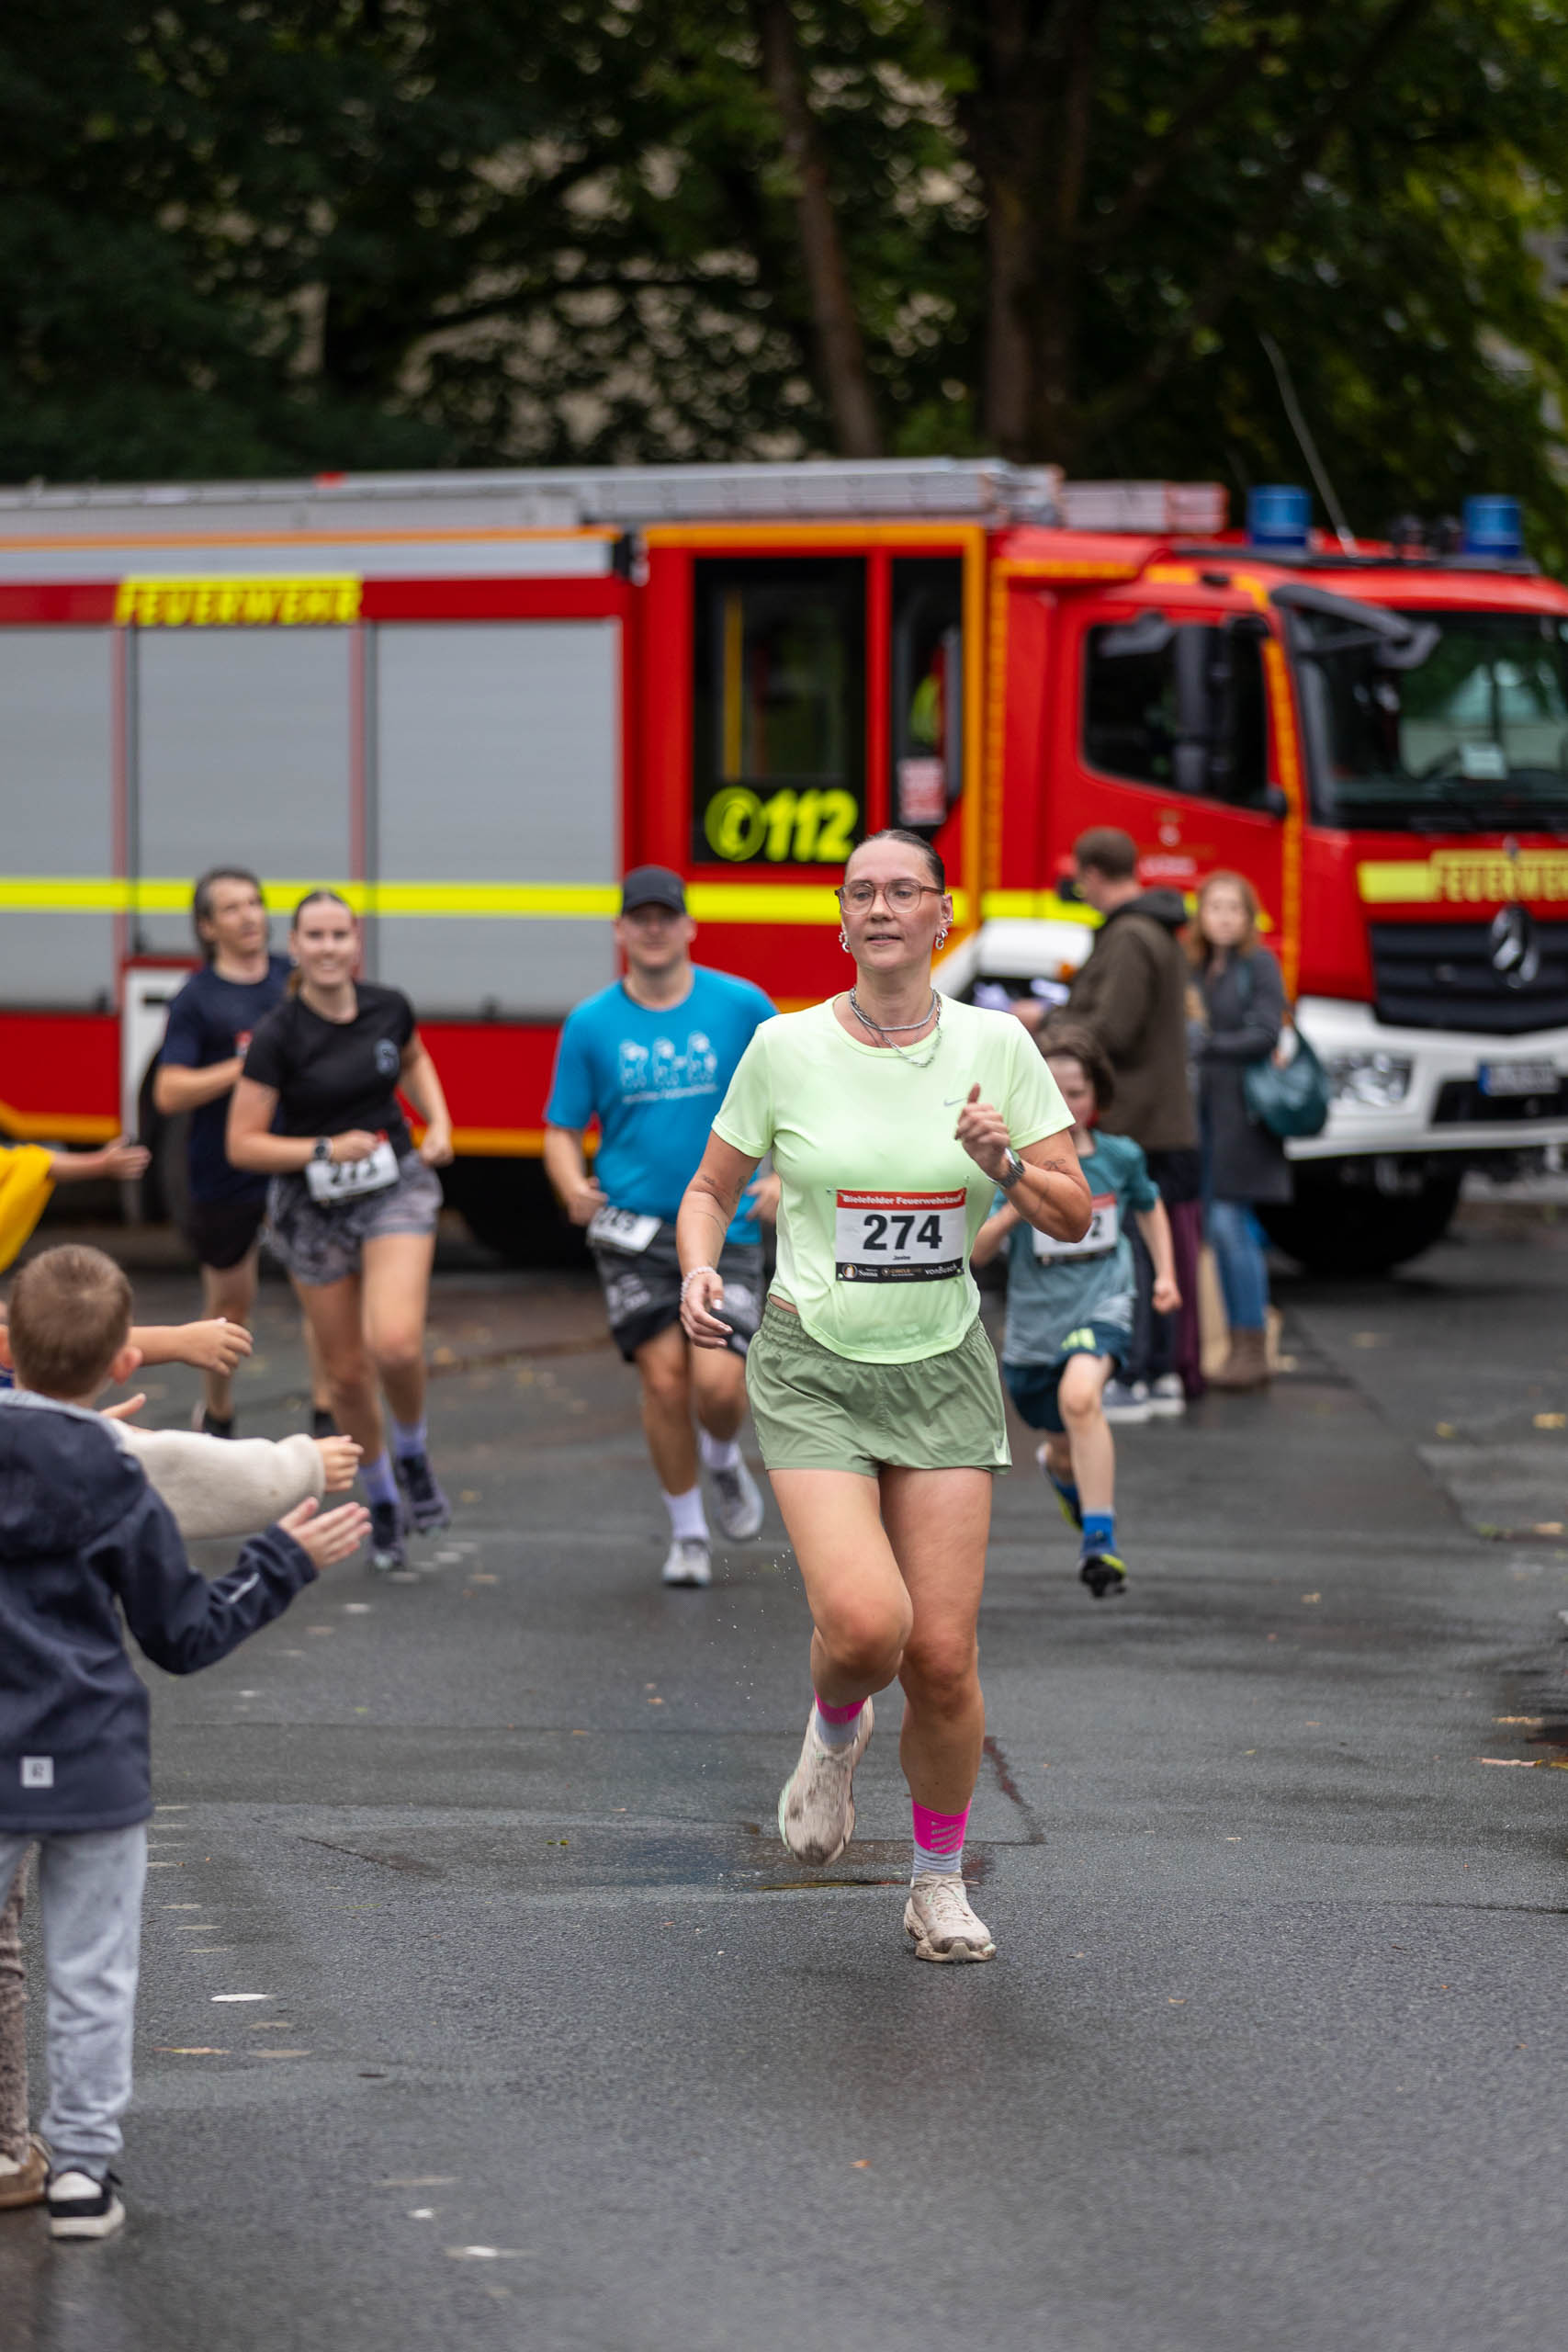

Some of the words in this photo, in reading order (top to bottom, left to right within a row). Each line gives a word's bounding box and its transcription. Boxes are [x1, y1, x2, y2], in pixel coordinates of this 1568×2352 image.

[115, 581, 362, 627] FEUERWEHR
[763, 787, 858, 863] 112
[842, 1193, 895, 1205] Bielefelder
[896, 1194, 963, 1205] Feuerwehrlauf
[863, 1214, 943, 1250] 274
